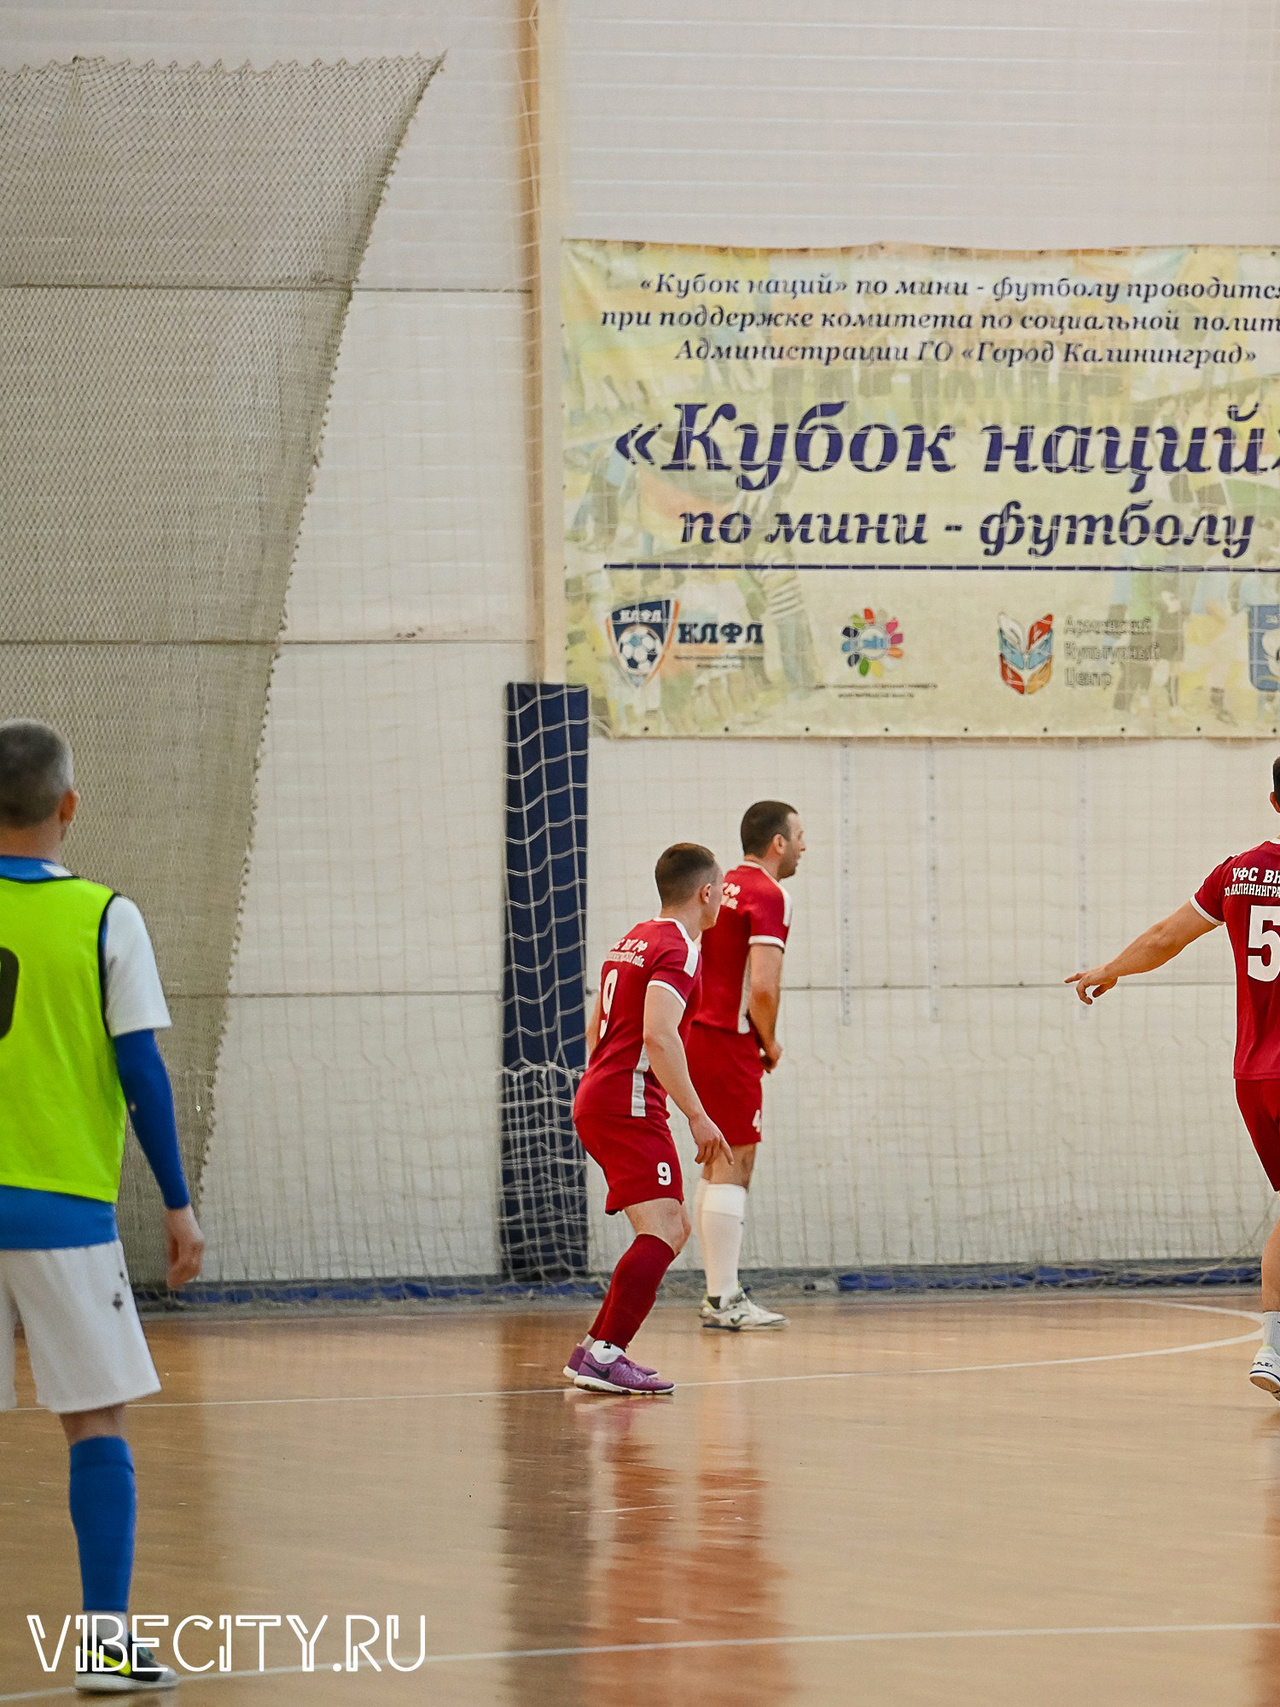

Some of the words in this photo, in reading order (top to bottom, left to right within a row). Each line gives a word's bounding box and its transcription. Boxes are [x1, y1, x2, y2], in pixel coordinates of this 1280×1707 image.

[640, 273, 739, 299] «Кубок
[749, 273, 847, 300] наций»
[856, 280, 887, 295] по
[895, 281, 967, 296] мини
[992, 276, 1120, 302] футболу
[601, 311, 651, 331] при
[659, 304, 813, 332] поддержке
[821, 312, 972, 329] комитета
[980, 312, 1012, 330] по
[1021, 310, 1180, 336] социальной
[674, 339, 908, 366] Администрации
[917, 341, 953, 362] ГО
[961, 339, 1055, 367] «Город
[1064, 342, 1258, 368] Калининград»
[615, 401, 957, 491] «Кубок
[679, 510, 752, 544] по
[764, 510, 929, 545] мини
[979, 500, 1255, 559] футболу
[677, 622, 764, 644] КЛФЛ
[1232, 867, 1259, 882] УФС
[600, 968, 618, 1039] 9
[656, 1161, 672, 1186] 9
